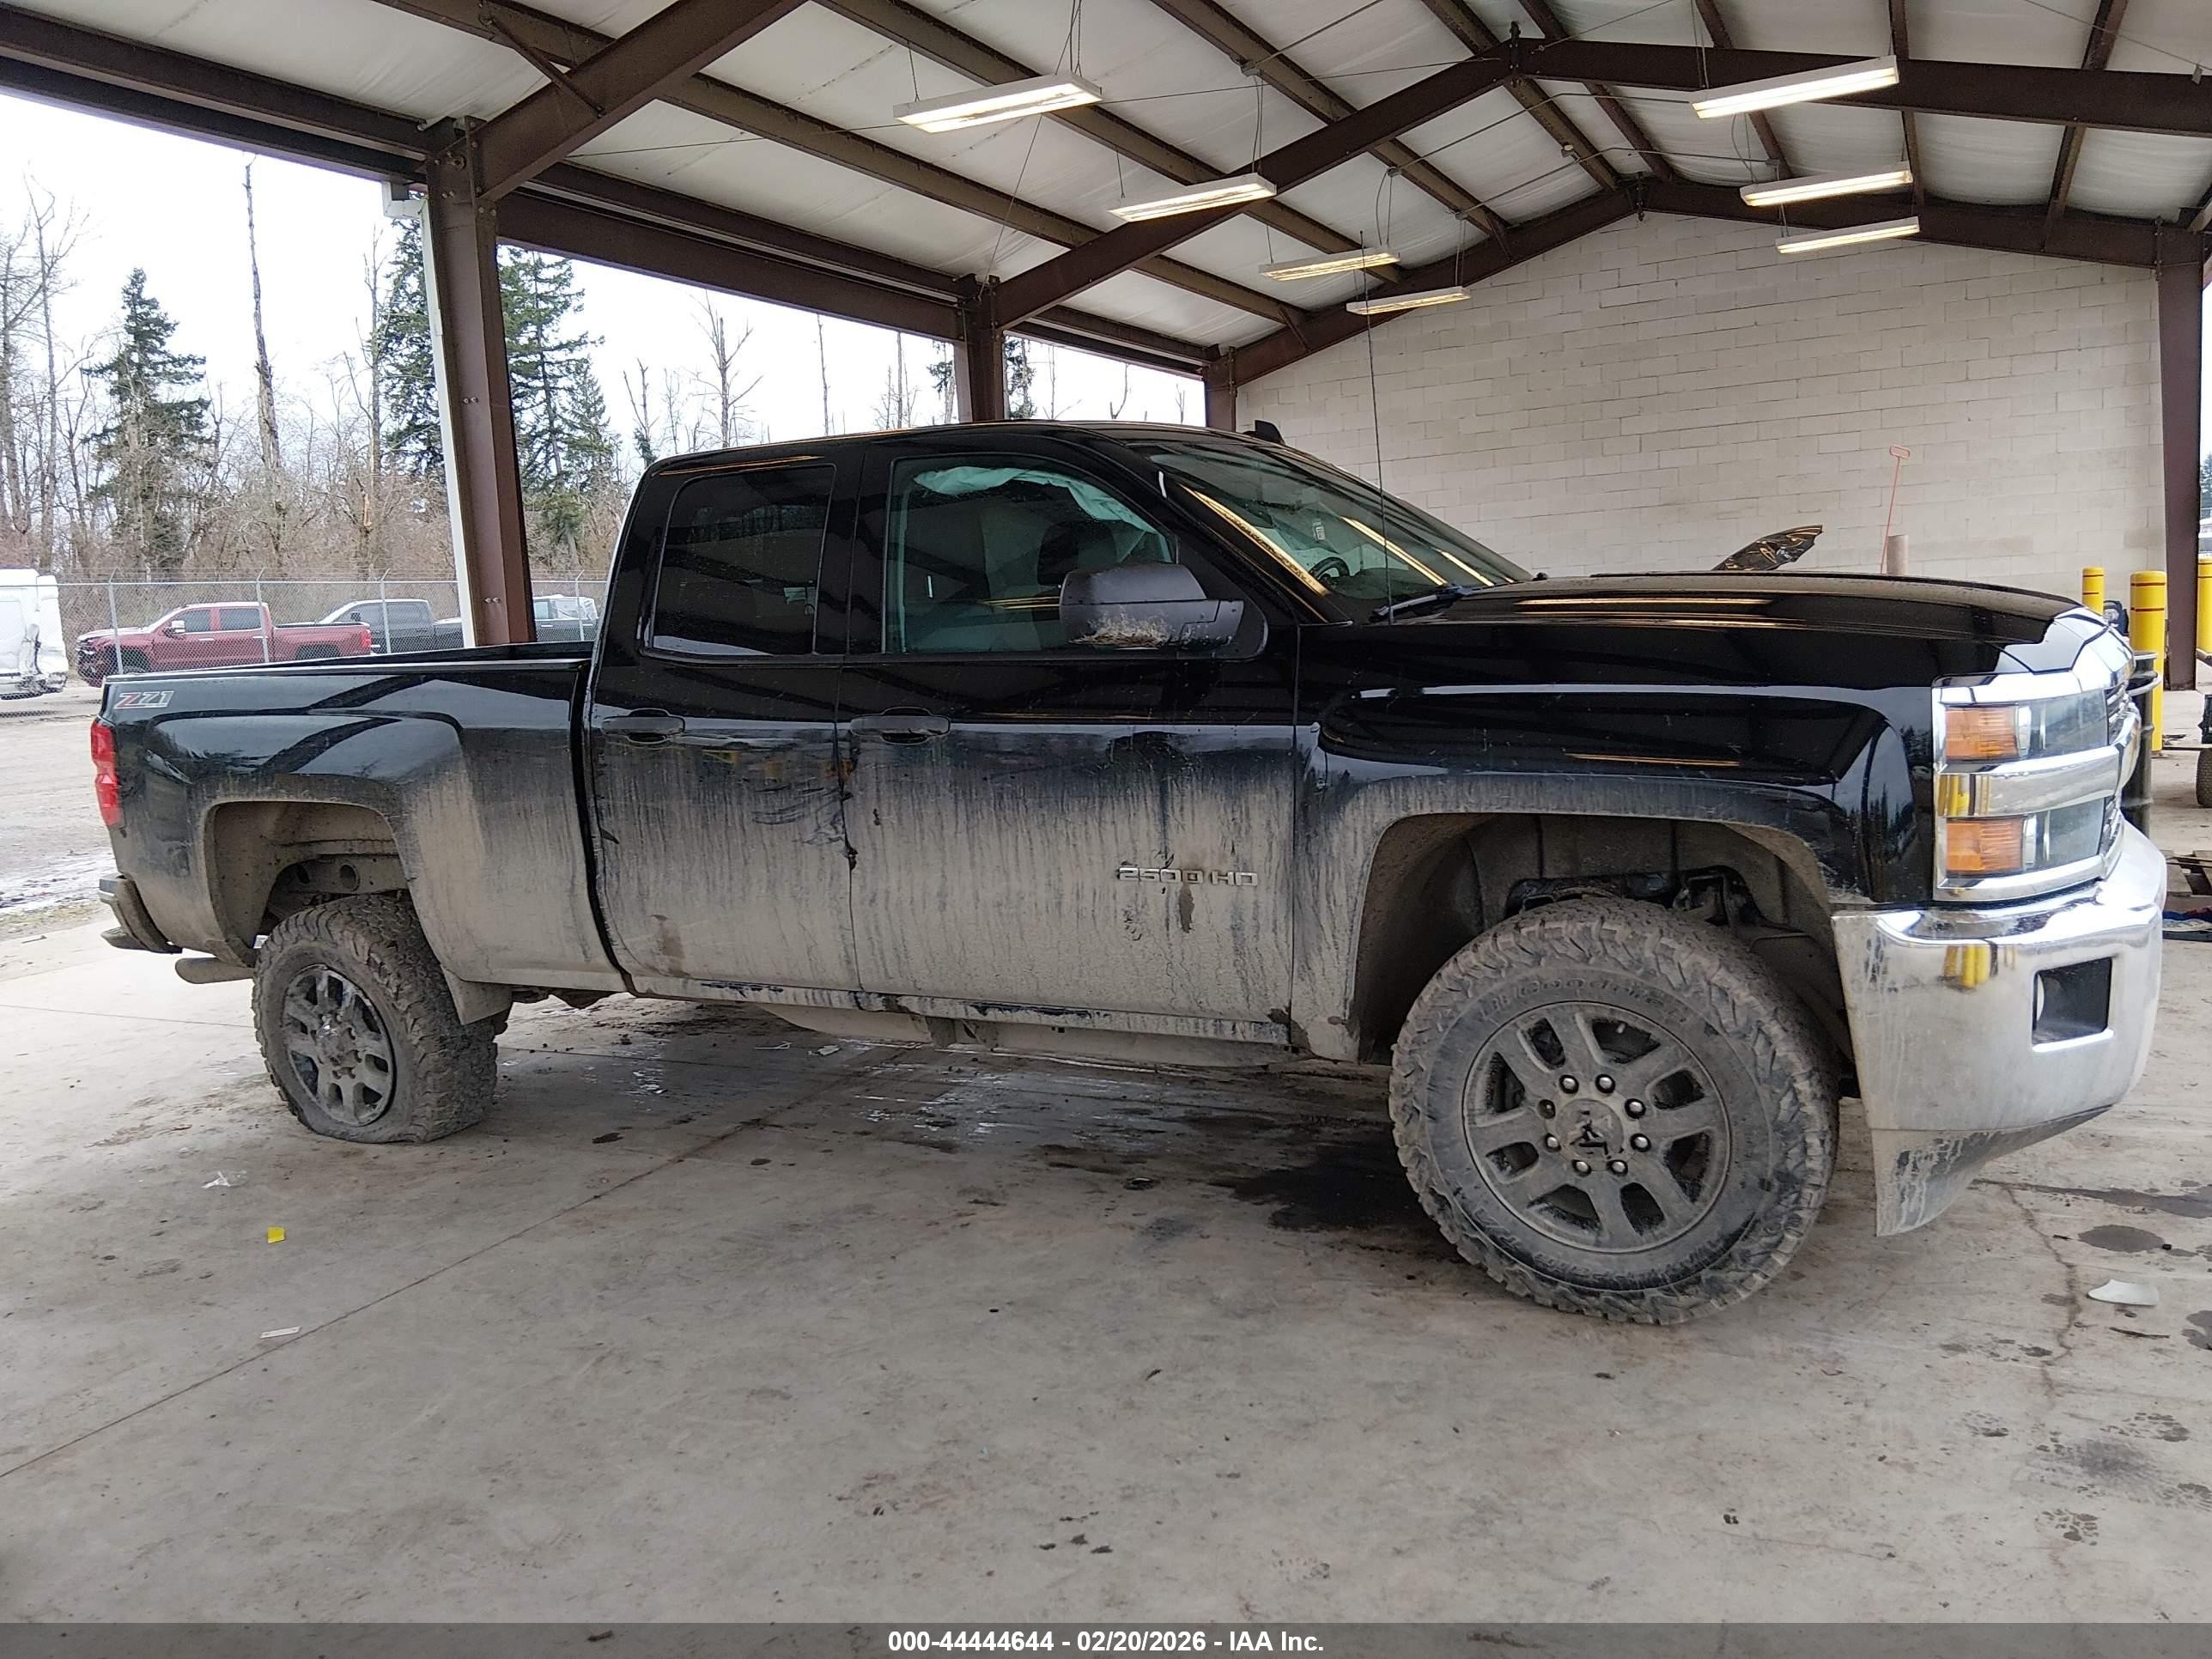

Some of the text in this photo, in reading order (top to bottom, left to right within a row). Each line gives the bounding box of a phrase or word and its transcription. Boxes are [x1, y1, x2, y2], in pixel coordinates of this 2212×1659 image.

[113, 690, 174, 709] Z71
[1118, 866, 1259, 887] 2500 HD
